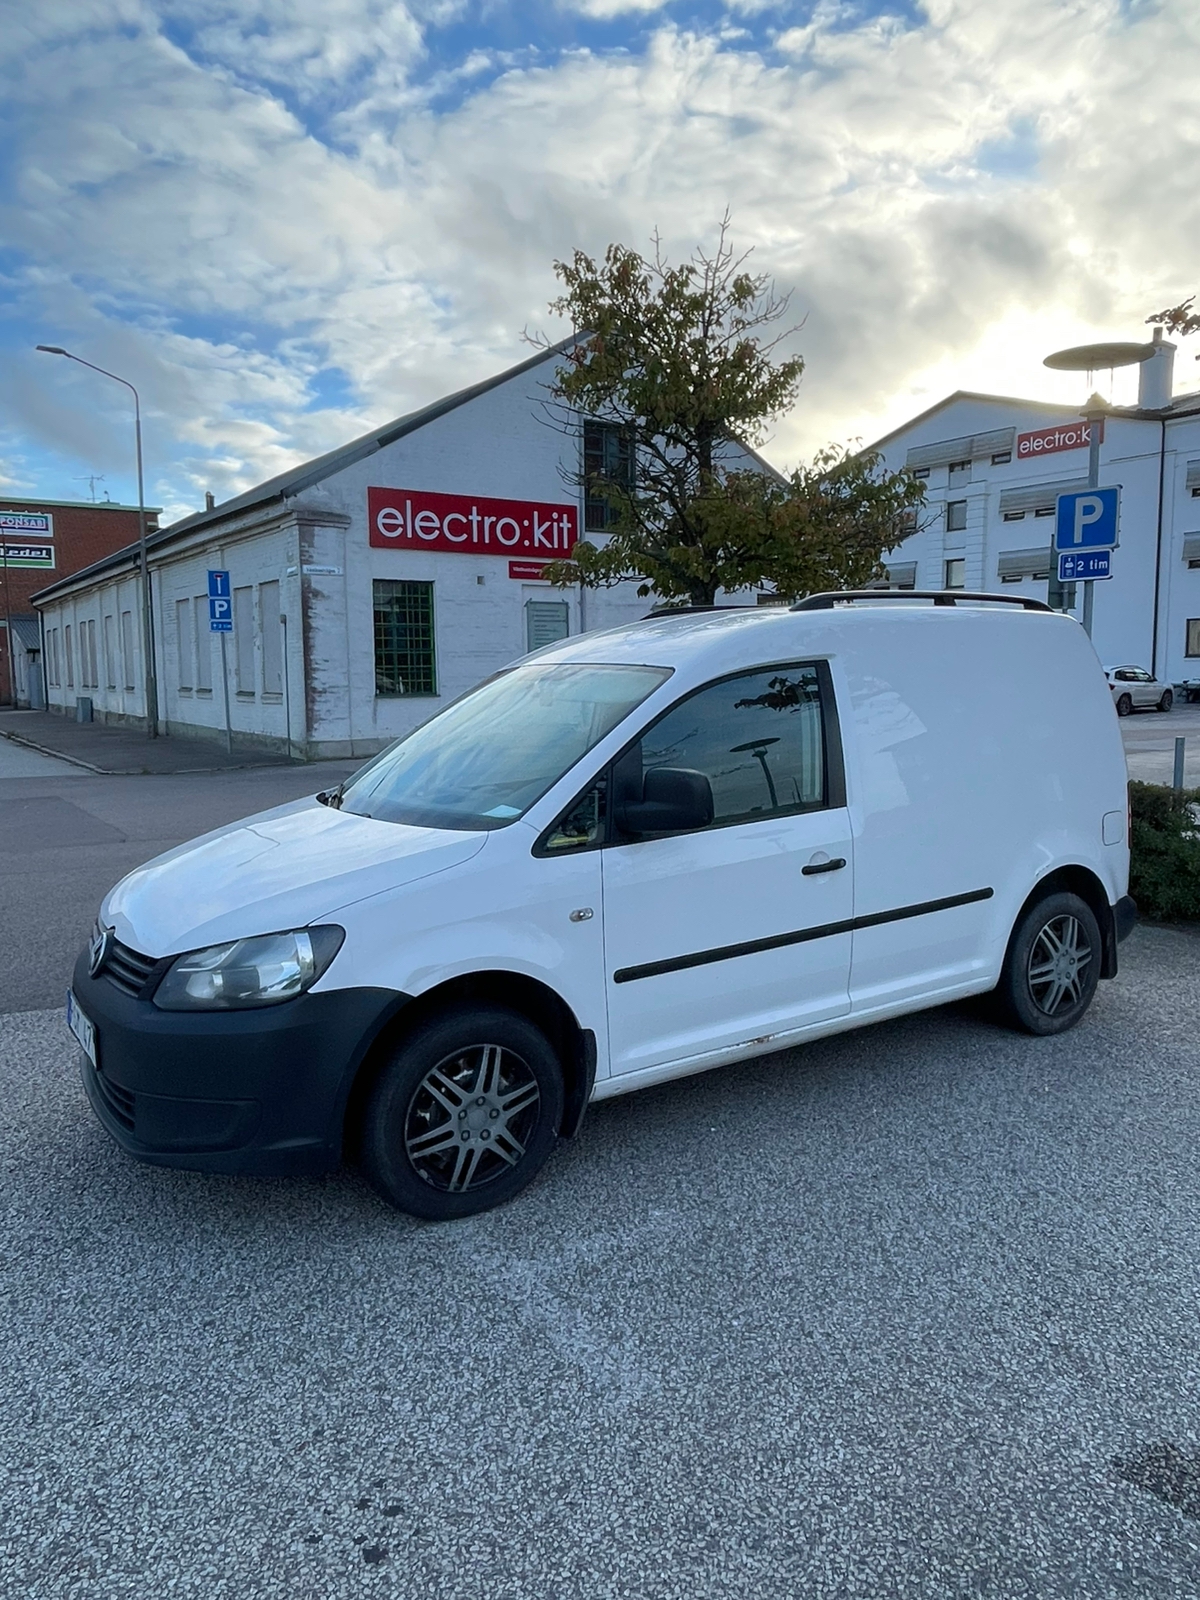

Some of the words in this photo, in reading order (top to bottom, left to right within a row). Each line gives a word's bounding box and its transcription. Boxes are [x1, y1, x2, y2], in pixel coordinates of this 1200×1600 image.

[1019, 426, 1091, 454] electro:k
[376, 499, 572, 550] electro:kit
[1073, 496, 1104, 543] P
[1077, 560, 1084, 571] 2
[1089, 559, 1108, 570] tim
[214, 600, 228, 618] P
